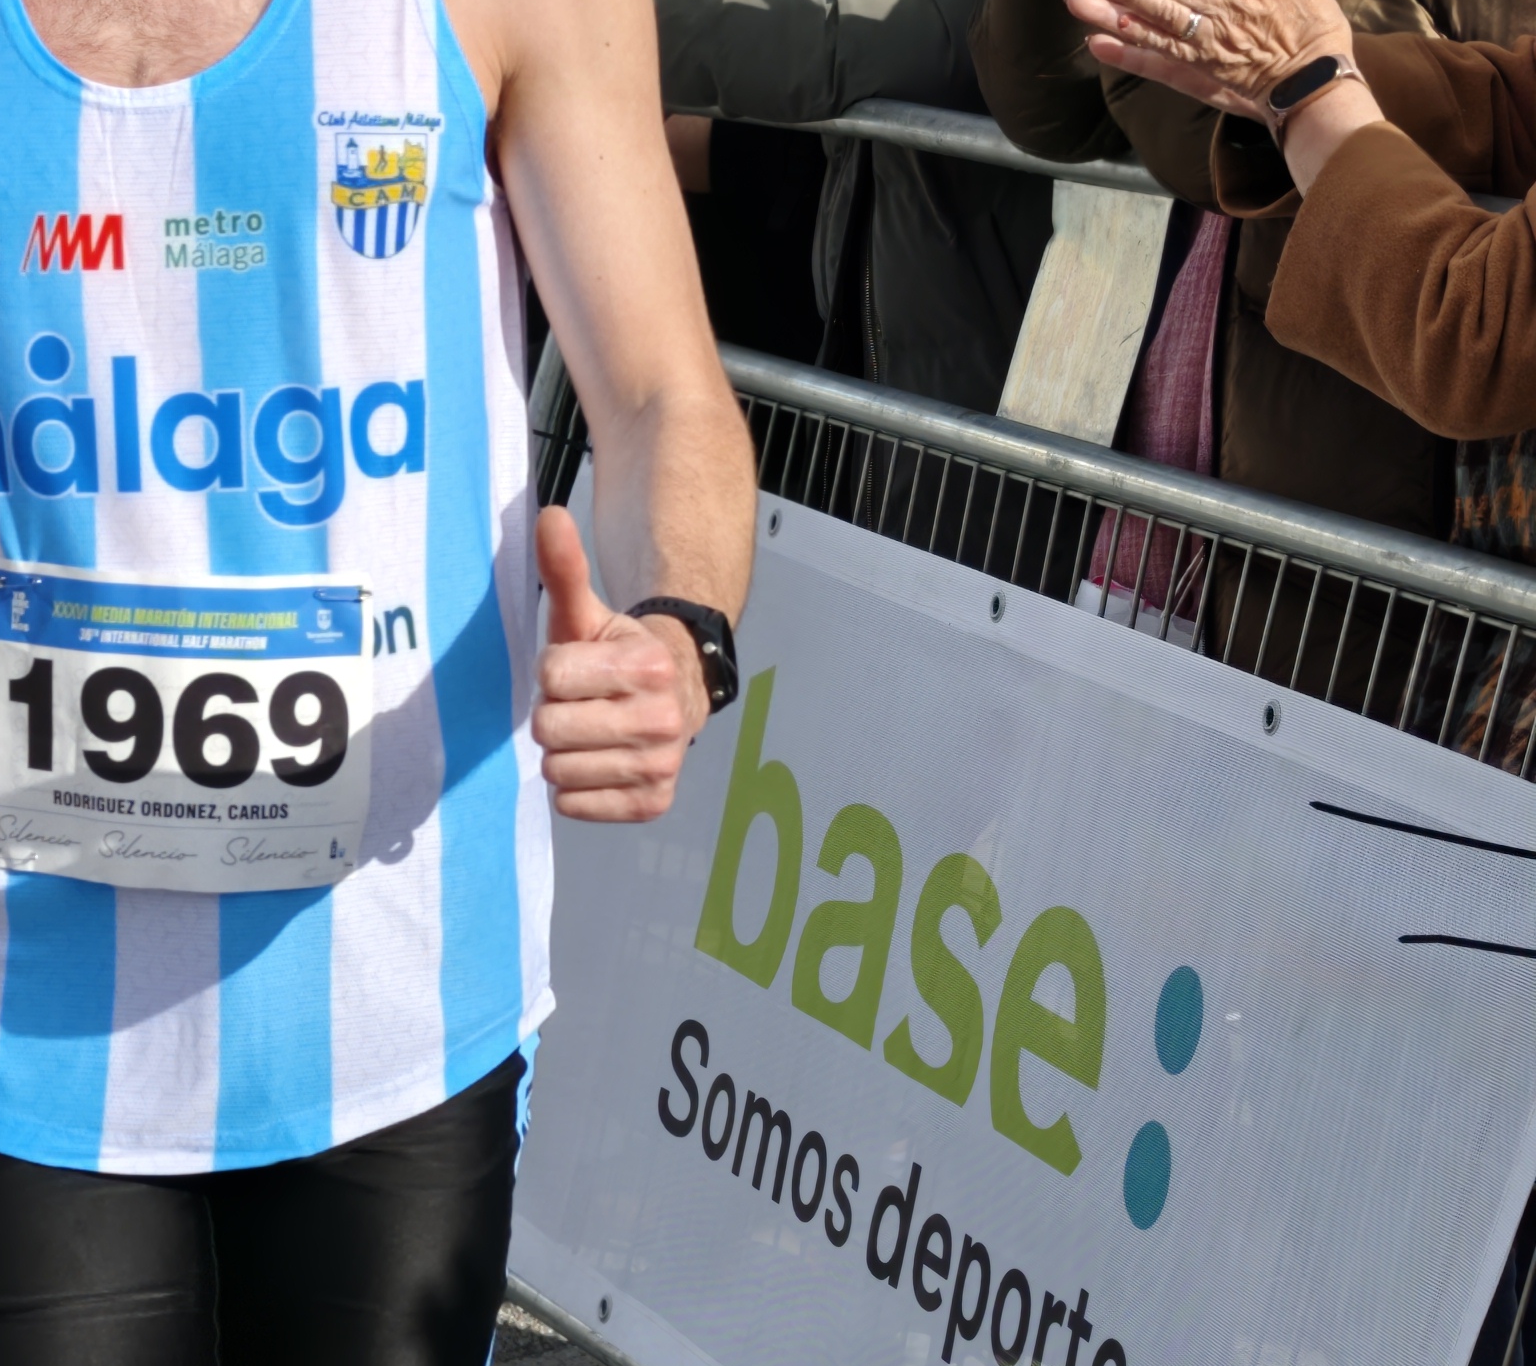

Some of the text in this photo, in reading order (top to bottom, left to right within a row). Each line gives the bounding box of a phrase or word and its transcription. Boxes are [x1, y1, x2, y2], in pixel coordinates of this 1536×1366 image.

[164, 210, 264, 237] metro
[165, 242, 266, 272] Málaga
[90, 605, 132, 624] MEDIA
[197, 611, 299, 630] INTERNACIONAL
[100, 629, 181, 648] INTERNATIONAL
[181, 635, 210, 649] HALF
[209, 635, 269, 651] MARATHON
[7, 657, 350, 790] 1969
[52, 789, 289, 823] RODRIGUEZ ORDONEZ, CARLOS
[97, 829, 198, 861] Silencio
[219, 835, 319, 866] Silencio
[658, 1017, 860, 1248] Somos
